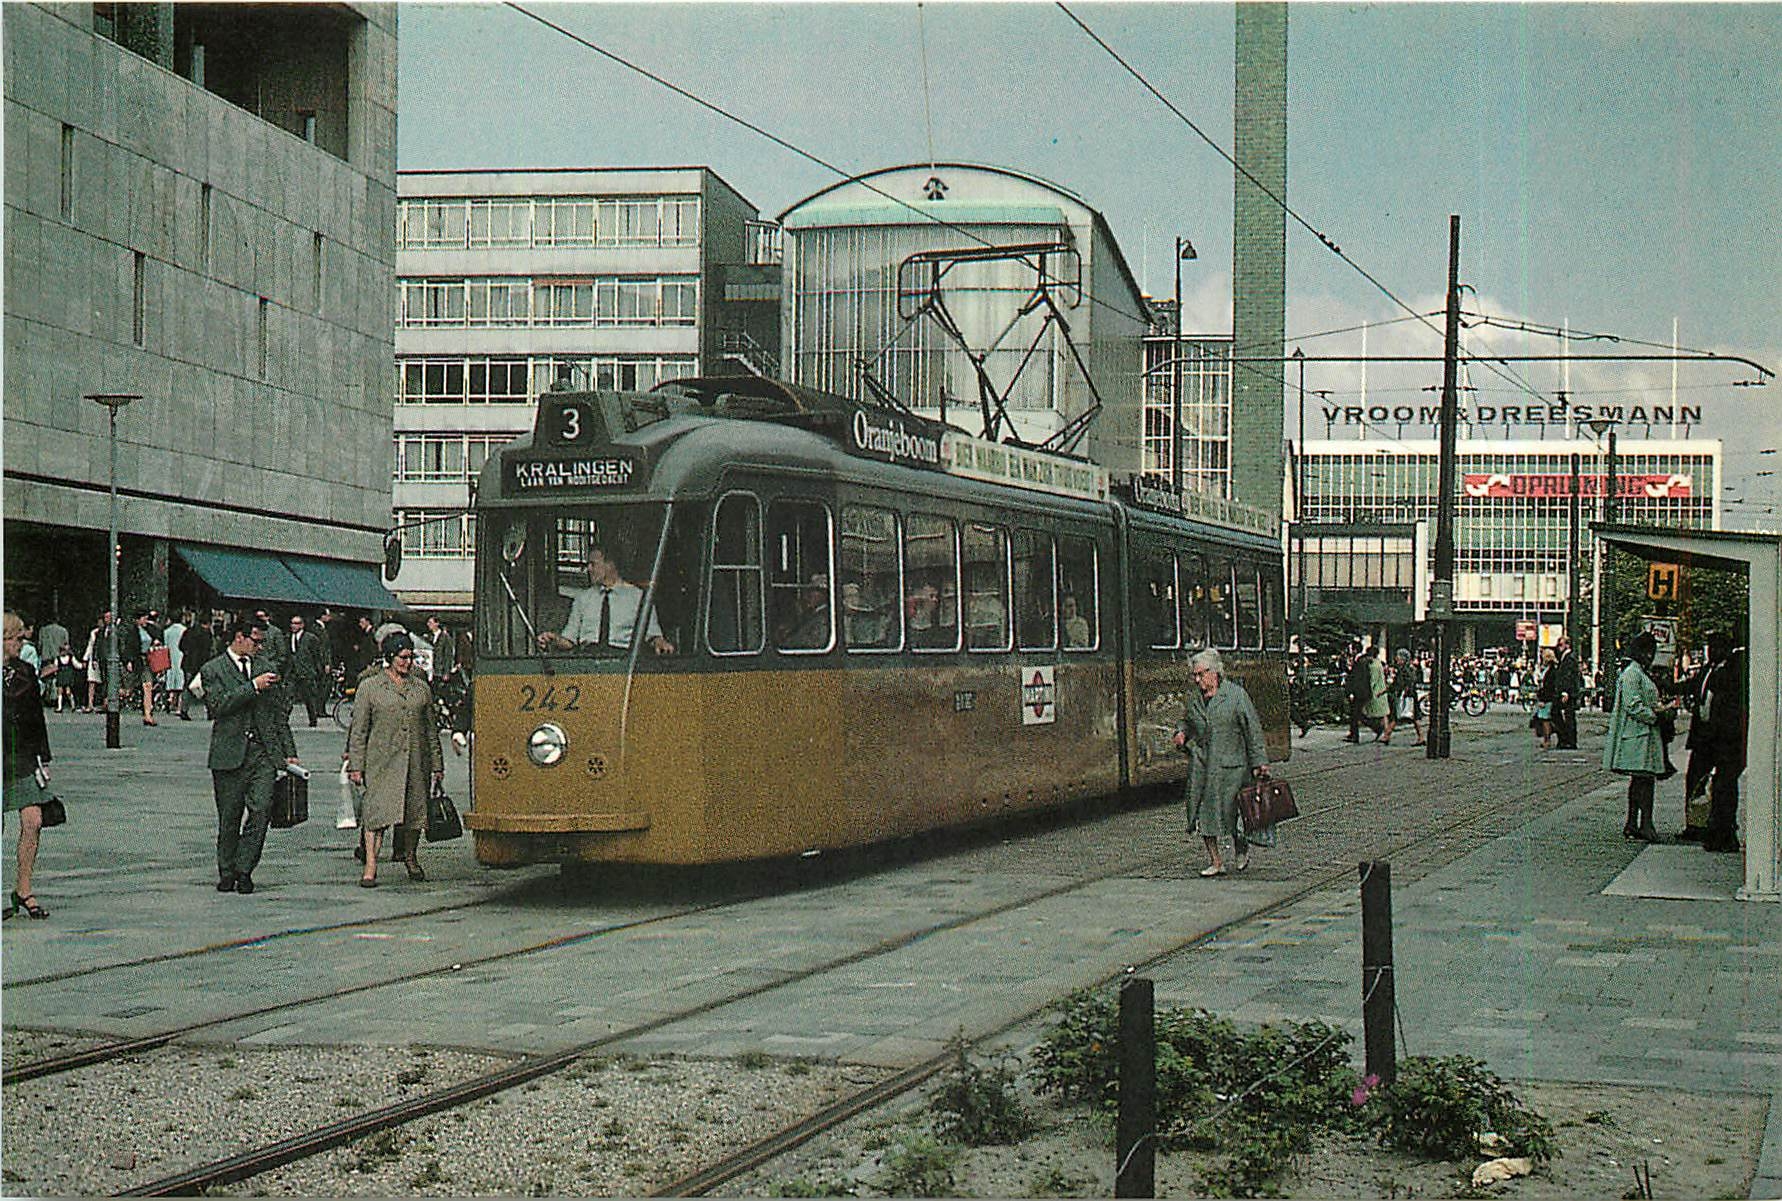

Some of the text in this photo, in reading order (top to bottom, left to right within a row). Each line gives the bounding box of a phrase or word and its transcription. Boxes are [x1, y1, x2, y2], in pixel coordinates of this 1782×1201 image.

[561, 408, 580, 440] 3
[1322, 406, 1442, 424] VROOM
[1477, 405, 1701, 424] DREESMANN
[853, 410, 938, 463] Oranjeboom
[516, 459, 633, 477] KRALINGEN
[1653, 569, 1676, 598] H
[520, 684, 581, 712] 242
